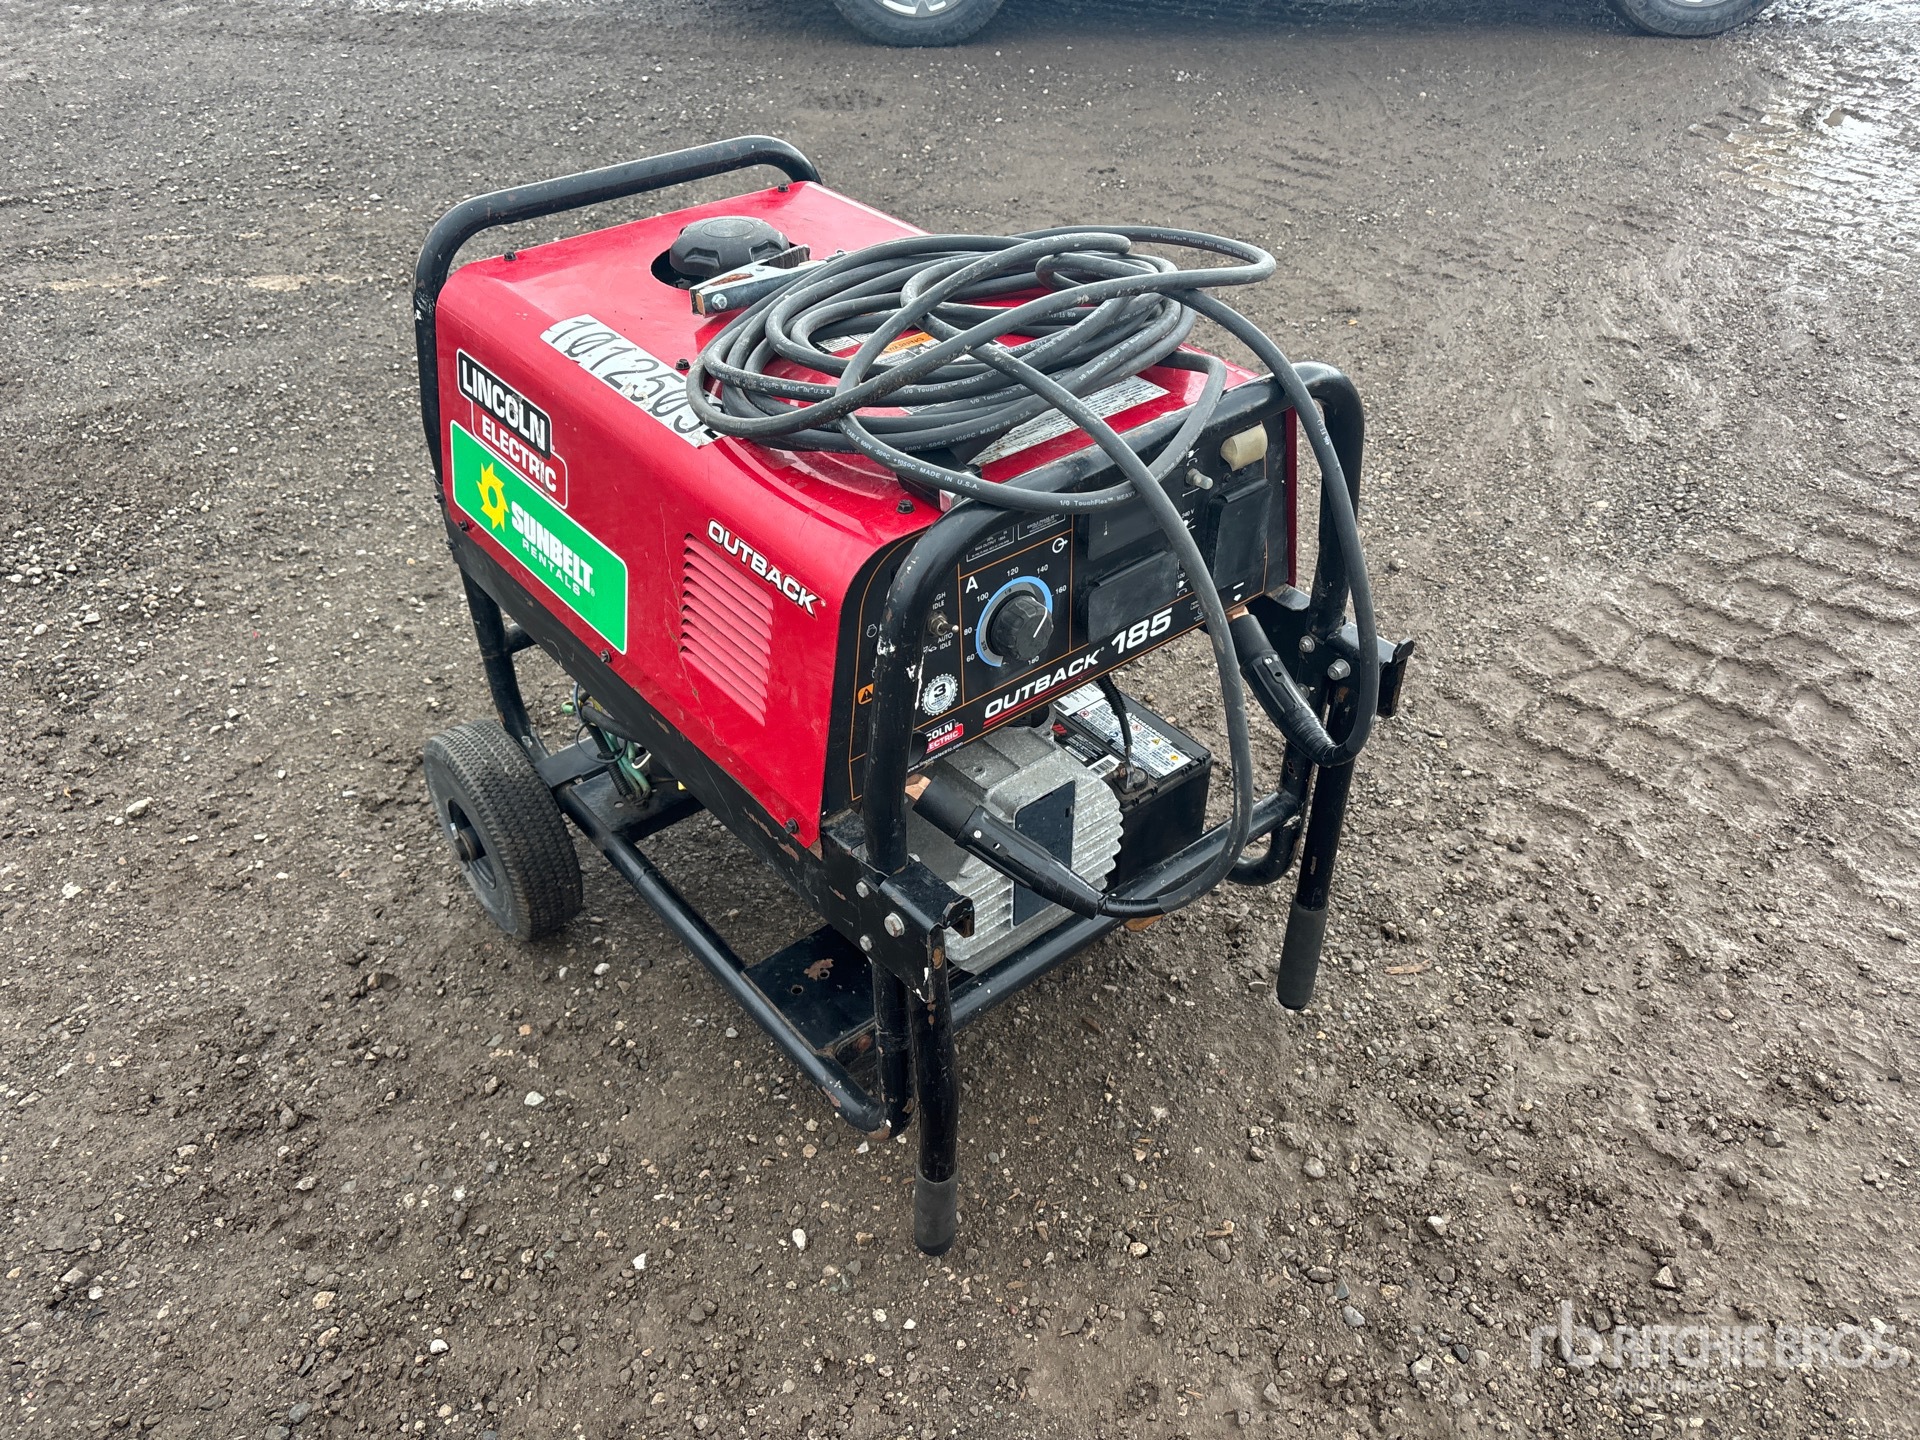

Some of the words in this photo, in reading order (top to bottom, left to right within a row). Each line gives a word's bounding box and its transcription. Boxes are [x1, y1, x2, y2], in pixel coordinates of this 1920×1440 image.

[462, 359, 546, 452] LINCOLN
[980, 424, 1000, 435] MADE
[1003, 419, 1011, 427] IN
[481, 414, 557, 493] ELECTRIC
[846, 428, 860, 443] CABLE
[860, 439, 873, 451] 600V
[919, 467, 942, 479] MADE
[944, 475, 953, 483] IN
[957, 479, 981, 491] U.S.A.
[511, 500, 594, 594] SUNBELT
[522, 537, 581, 597] RENTALS
[707, 518, 818, 617] OUTBACK
[1006, 566, 1019, 577] 120
[1037, 564, 1049, 575] 140
[965, 575, 979, 594] A
[1055, 584, 1067, 595] 160
[976, 592, 990, 602] 100
[932, 601, 945, 610] IDLE
[937, 632, 954, 644] AUTO
[963, 627, 973, 636] 80
[939, 640, 952, 650] IDLE
[966, 654, 975, 663] 60
[984, 649, 1101, 719] OUTBACK
[1112, 607, 1173, 655] 185
[933, 683, 947, 698] 3
